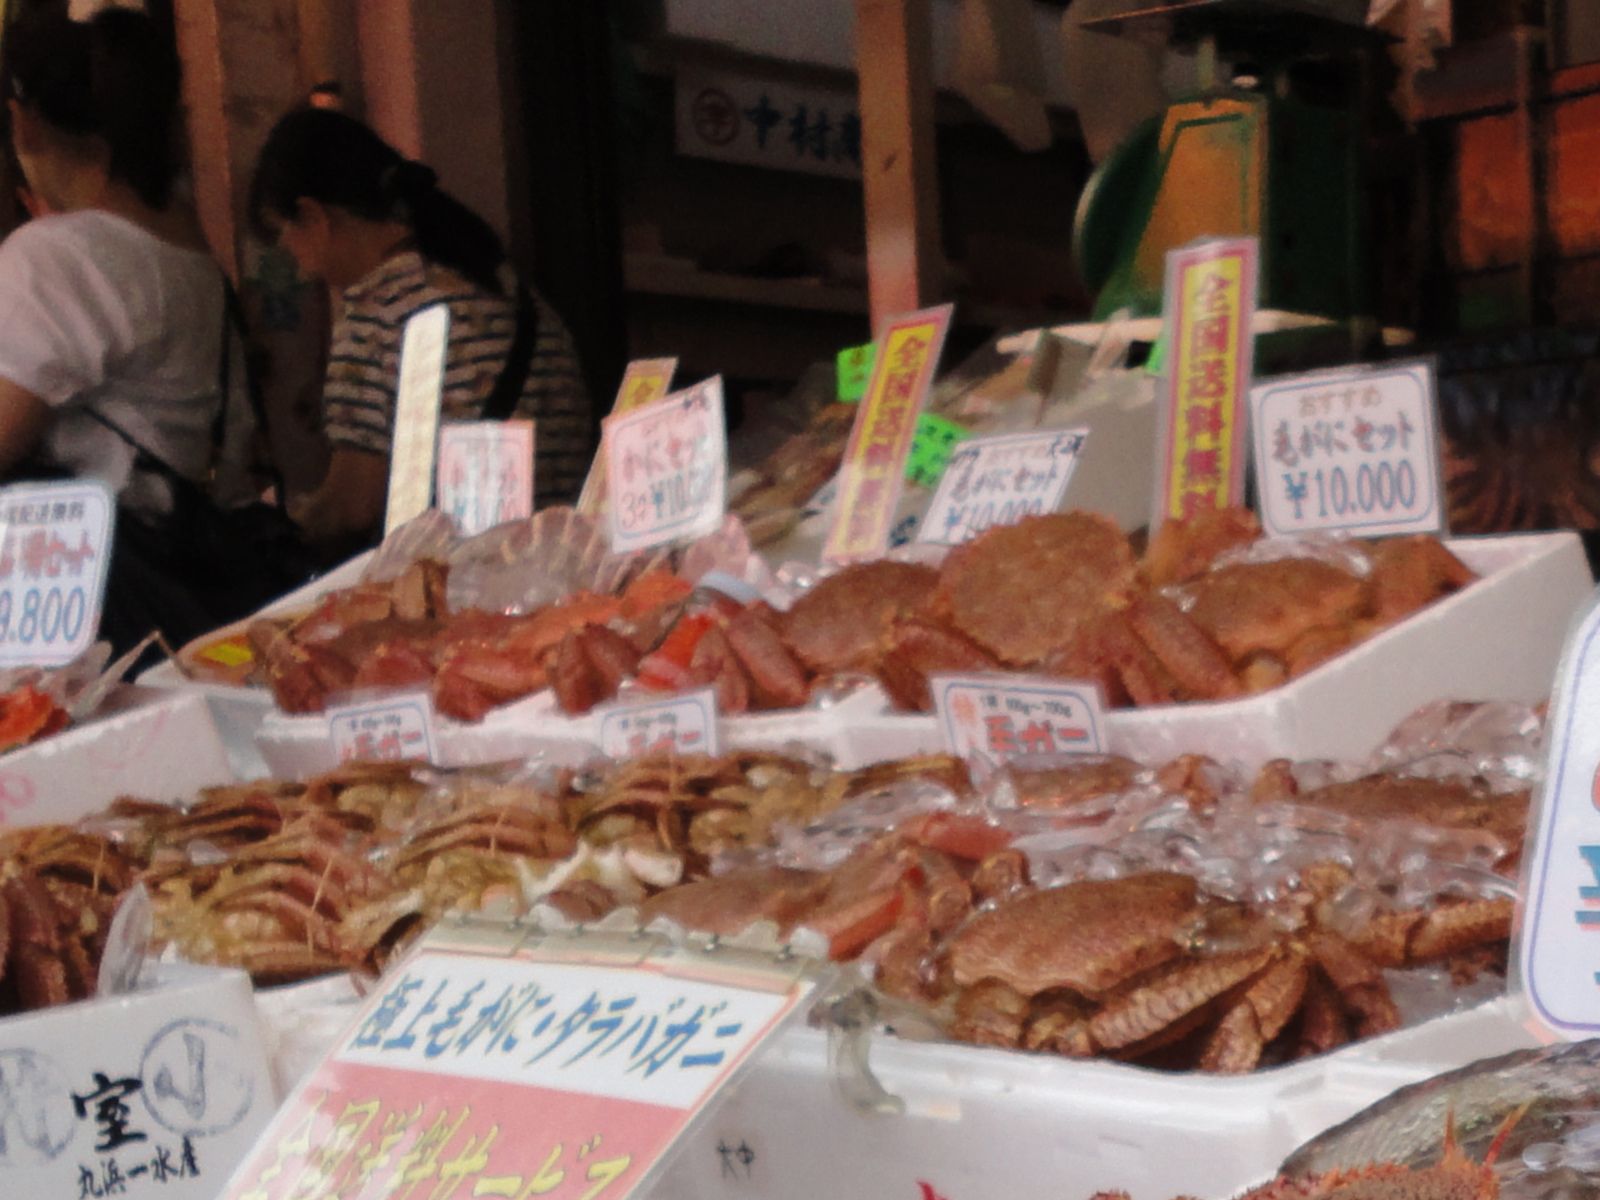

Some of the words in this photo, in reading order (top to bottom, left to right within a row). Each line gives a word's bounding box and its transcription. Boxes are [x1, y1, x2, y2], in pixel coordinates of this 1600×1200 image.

[1281, 459, 1417, 520] ¥10.000
[346, 974, 742, 1077] 極上毛がに・タラバガニ
